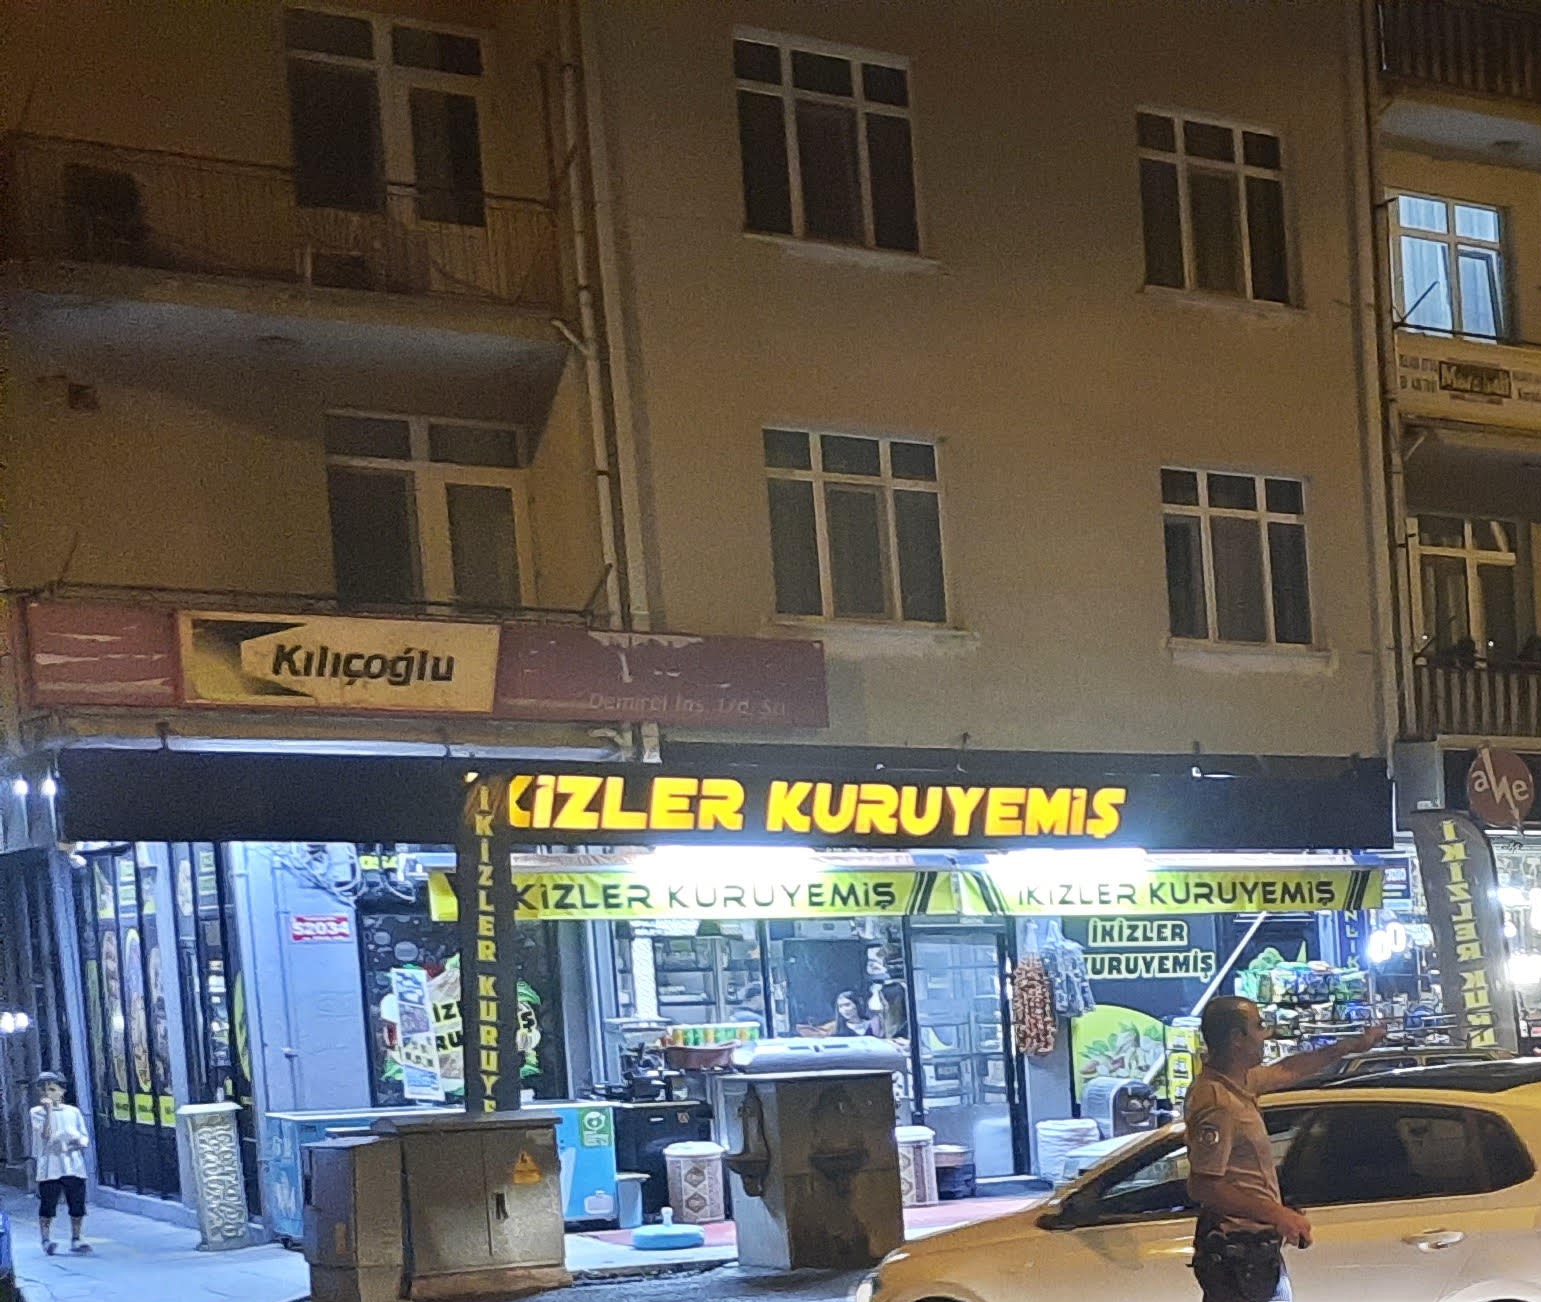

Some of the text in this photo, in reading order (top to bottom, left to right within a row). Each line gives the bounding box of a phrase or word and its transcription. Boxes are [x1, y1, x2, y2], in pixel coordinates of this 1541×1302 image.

[765, 780, 1127, 841] KURUYEMİŞ
[668, 884, 896, 911] KURUYEMİŞ
[1149, 880, 1335, 908] KURUYEMİŞ
[1091, 917, 1187, 944] İKİZLER
